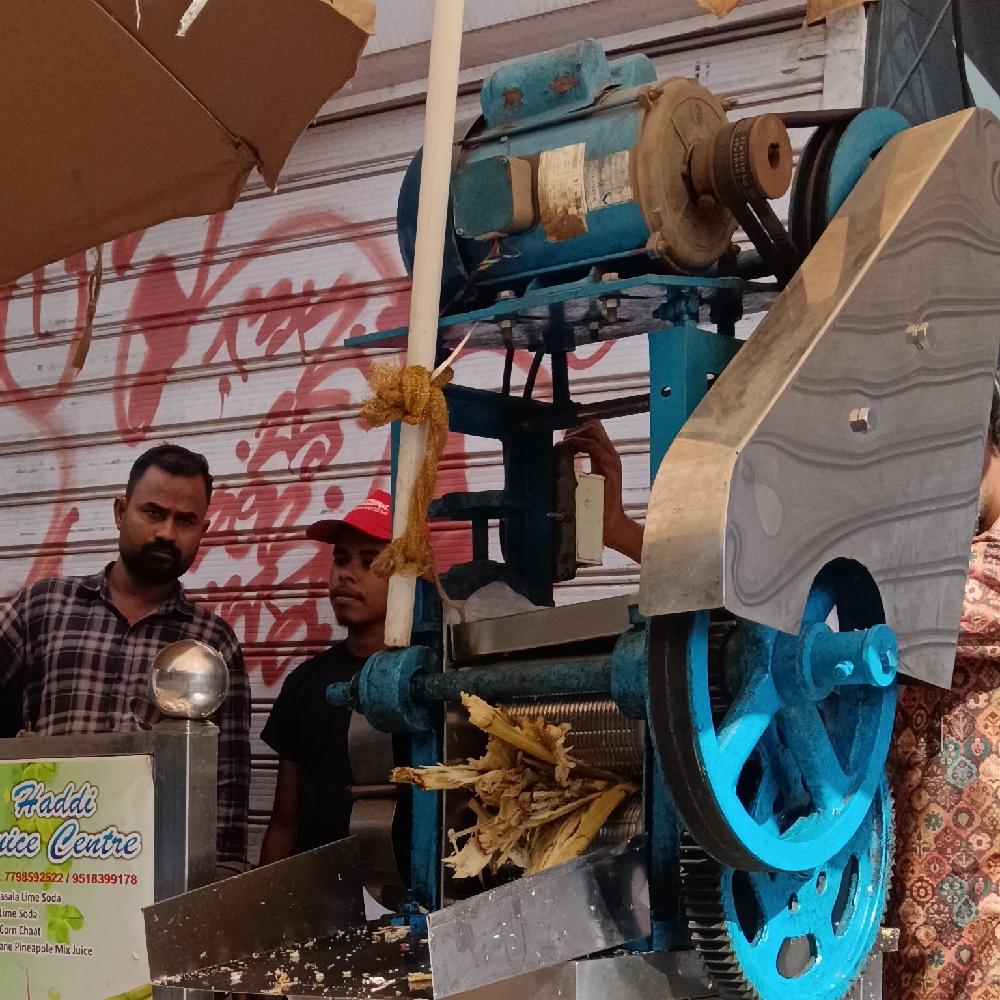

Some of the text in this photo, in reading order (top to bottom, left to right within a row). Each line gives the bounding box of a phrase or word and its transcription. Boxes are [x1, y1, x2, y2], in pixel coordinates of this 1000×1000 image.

[13, 782, 97, 816] Haddi
[49, 822, 139, 860] Centre
[21, 892, 40, 903] Lime
[41, 893, 62, 903] Soda
[18, 909, 38, 919] Soda
[0, 924, 17, 935] Corn
[14, 941, 54, 955] Pineapple
[55, 943, 71, 955] Mix
[72, 944, 93, 956] Juice
